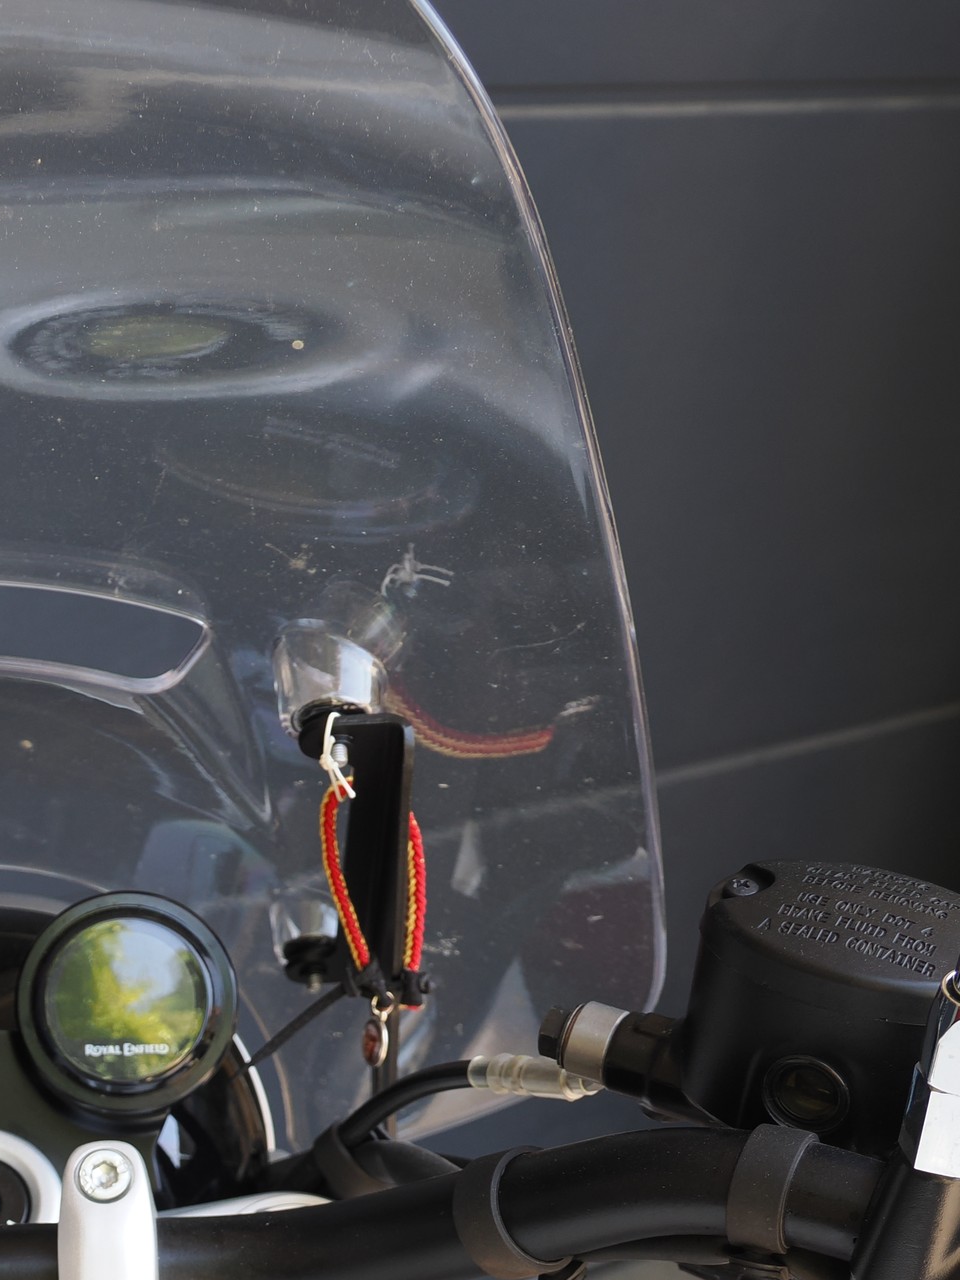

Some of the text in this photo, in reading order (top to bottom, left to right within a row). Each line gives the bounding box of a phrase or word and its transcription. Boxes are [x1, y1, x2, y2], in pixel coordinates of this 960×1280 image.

[797, 892, 935, 937] USE ONLY DOT 4
[802, 874, 948, 920] BEFORE REMOVING
[757, 917, 937, 977] A SEALED CONTAINER
[777, 903, 937, 957] BRAKE FLUID FROM
[84, 1042, 170, 1057] ROYAL ENFIELD
